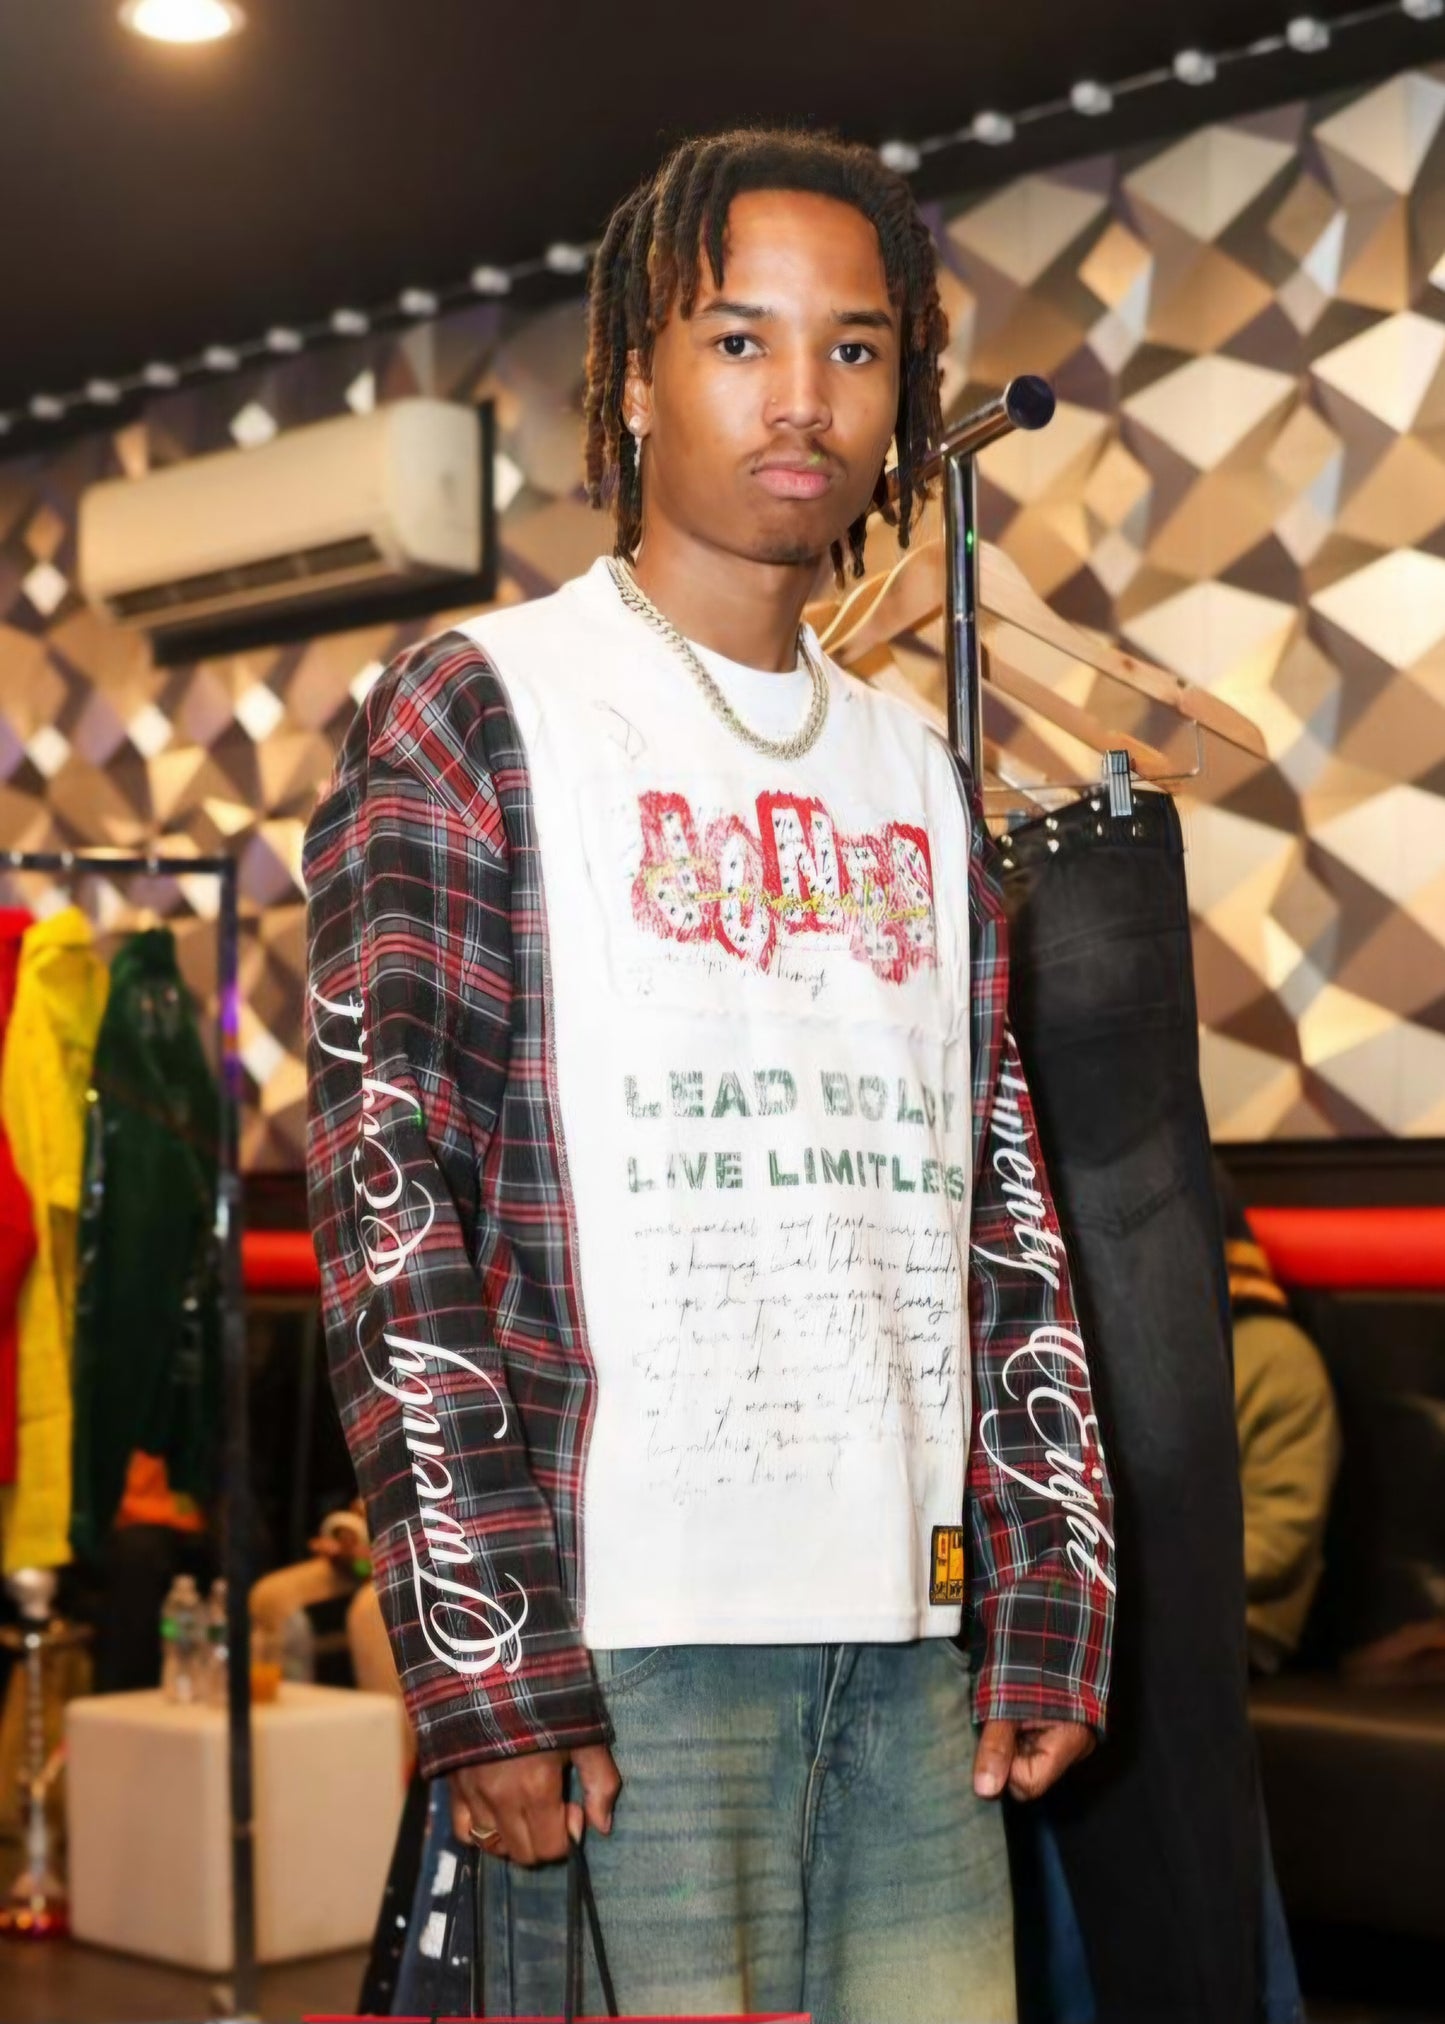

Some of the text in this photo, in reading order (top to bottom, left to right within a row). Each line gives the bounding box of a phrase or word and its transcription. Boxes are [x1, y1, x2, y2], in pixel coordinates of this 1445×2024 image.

[624, 1069, 798, 1119] LEAD
[626, 1152, 744, 1193] LIVE
[969, 1028, 1117, 1597] wenty Eight
[357, 1309, 528, 1677] Twenty
